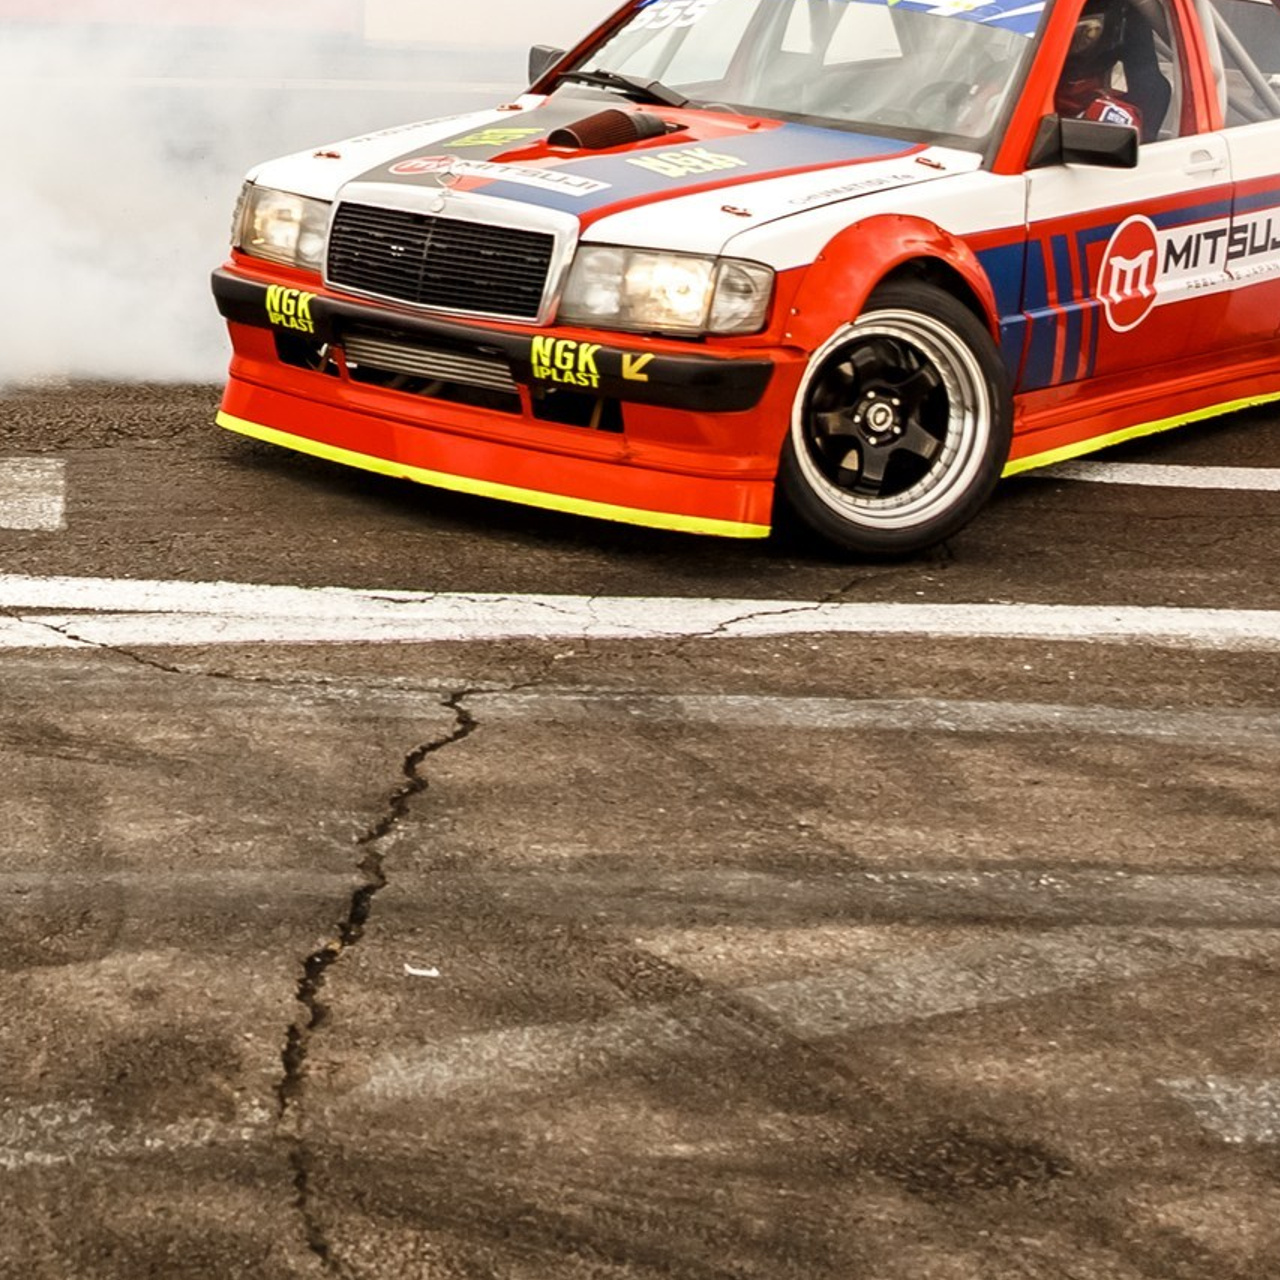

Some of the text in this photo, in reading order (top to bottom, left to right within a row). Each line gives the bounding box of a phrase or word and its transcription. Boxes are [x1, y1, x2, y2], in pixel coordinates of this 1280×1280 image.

[456, 160, 600, 190] MITSUJI
[1162, 217, 1280, 275] MITSU
[266, 284, 318, 320] NGK
[531, 335, 602, 374] NGK
